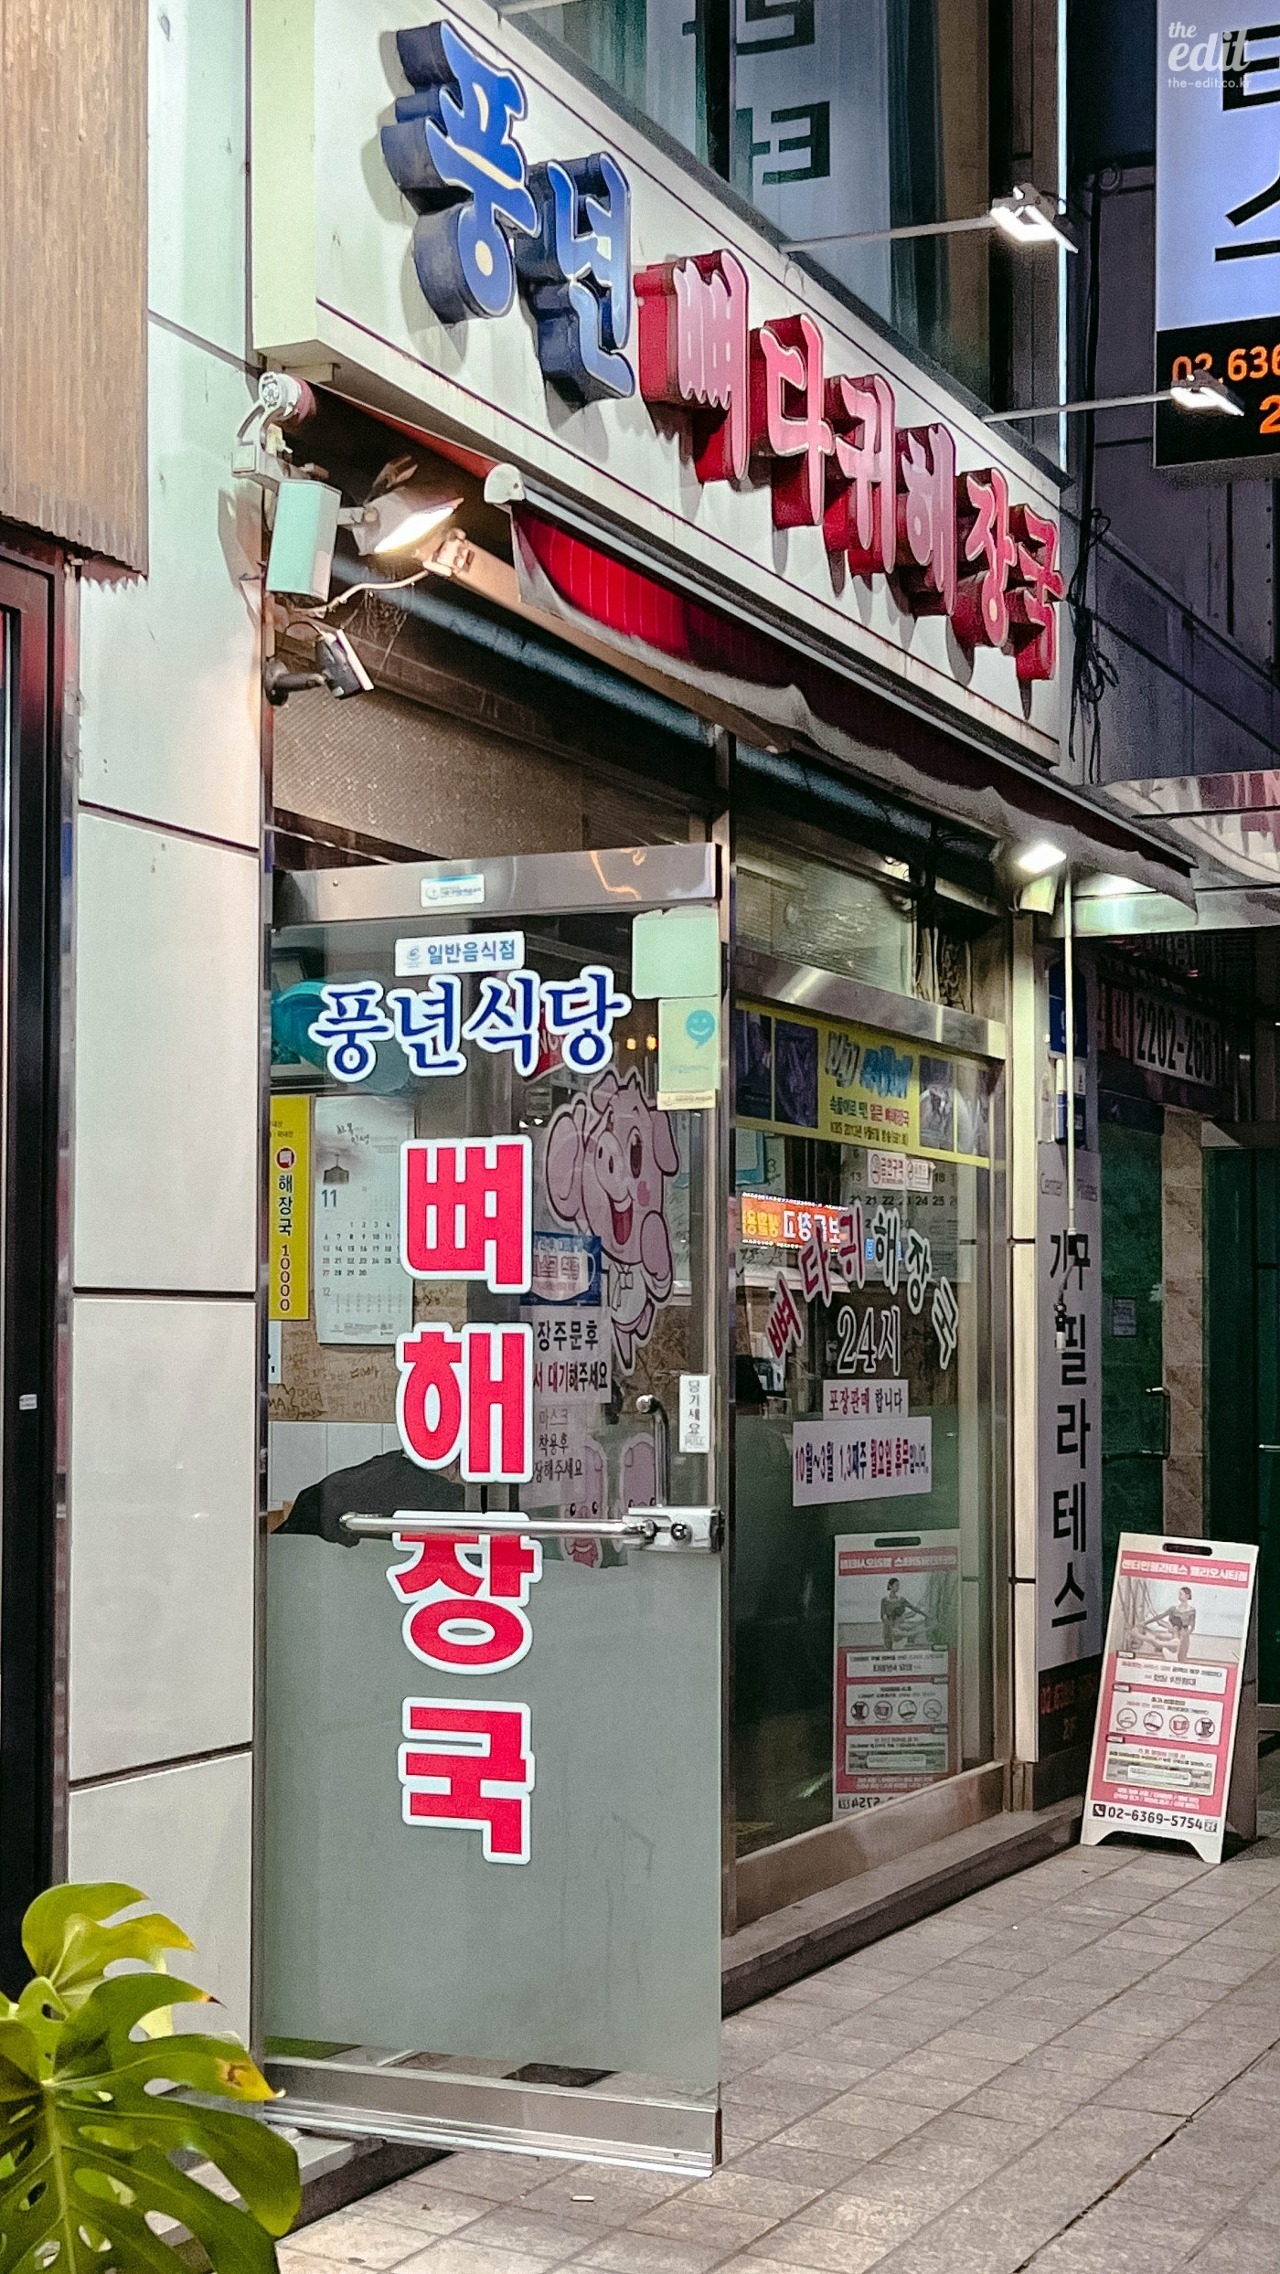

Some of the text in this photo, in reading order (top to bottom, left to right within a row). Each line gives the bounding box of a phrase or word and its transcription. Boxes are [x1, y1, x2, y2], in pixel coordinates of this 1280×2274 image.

[397, 20, 636, 404] 풍년
[427, 939, 516, 965] 일반음식점
[311, 970, 628, 1077] 풍년식당
[278, 1175, 293, 1236] 해장국
[321, 1189, 338, 1208] 11
[279, 1244, 291, 1312] 10000
[837, 1305, 901, 1376] 24시
[548, 1360, 608, 1394] 대기해주세요
[539, 1406, 568, 1429] 마스크
[688, 1379, 701, 1434] 당기세요
[829, 1386, 903, 1415] 포장판매 합니다
[538, 1432, 569, 1457] 착용후
[870, 1438, 892, 1479] 월요일
[392, 1139, 538, 1861] 뼈해장국
[1108, 1806, 1203, 1831] 02-6369-5754
